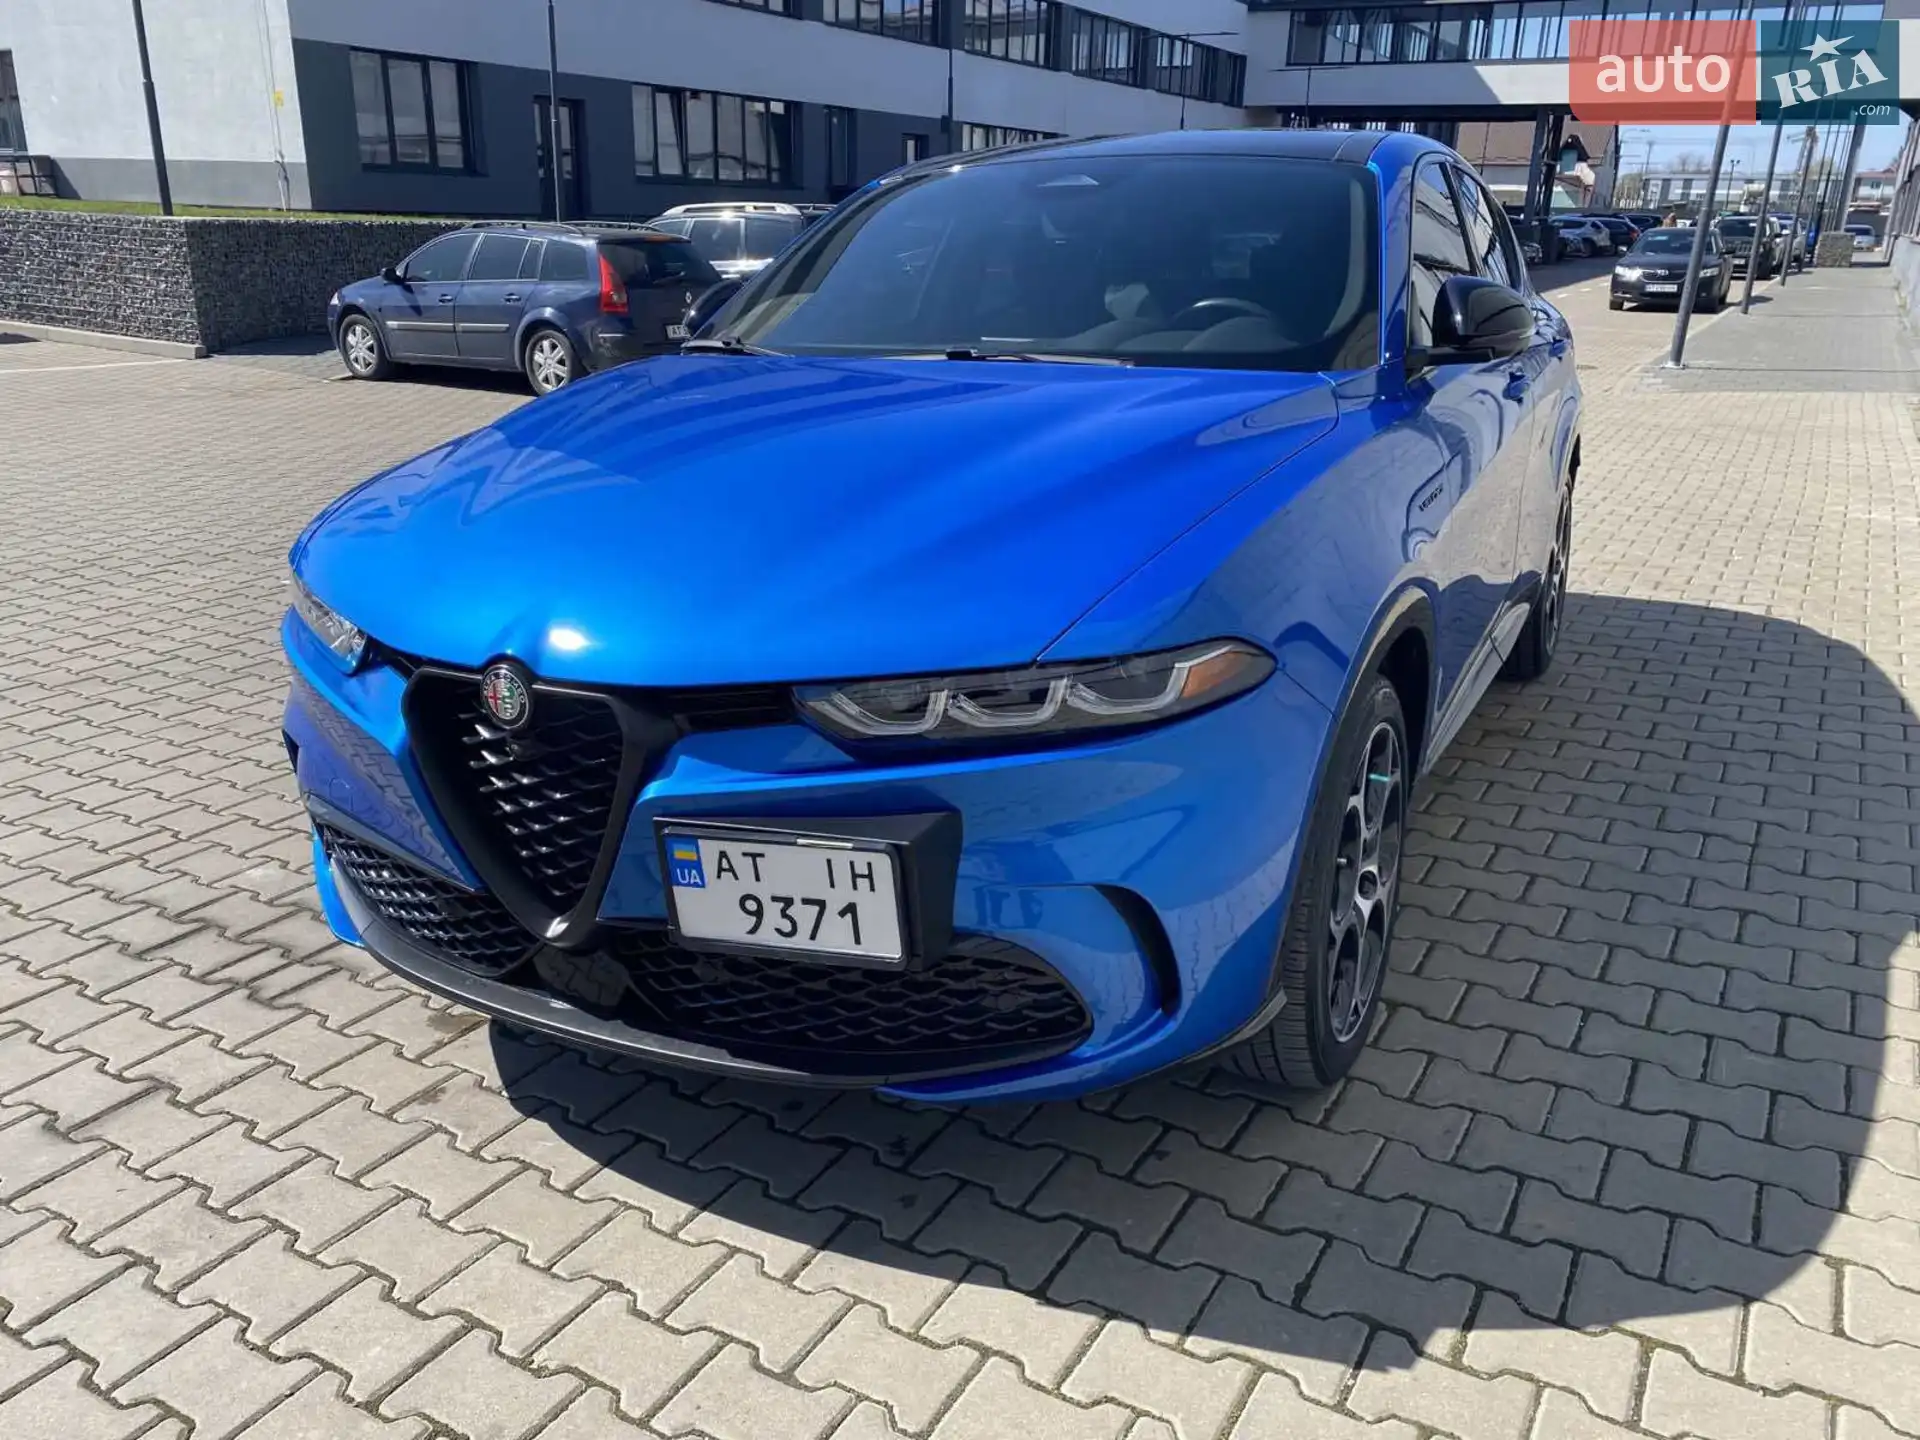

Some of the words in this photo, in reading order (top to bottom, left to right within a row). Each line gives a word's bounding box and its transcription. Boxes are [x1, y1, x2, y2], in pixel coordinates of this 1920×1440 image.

[676, 867, 702, 886] UA
[715, 850, 766, 883] AT
[825, 857, 876, 893] IH
[738, 893, 862, 946] 9371
